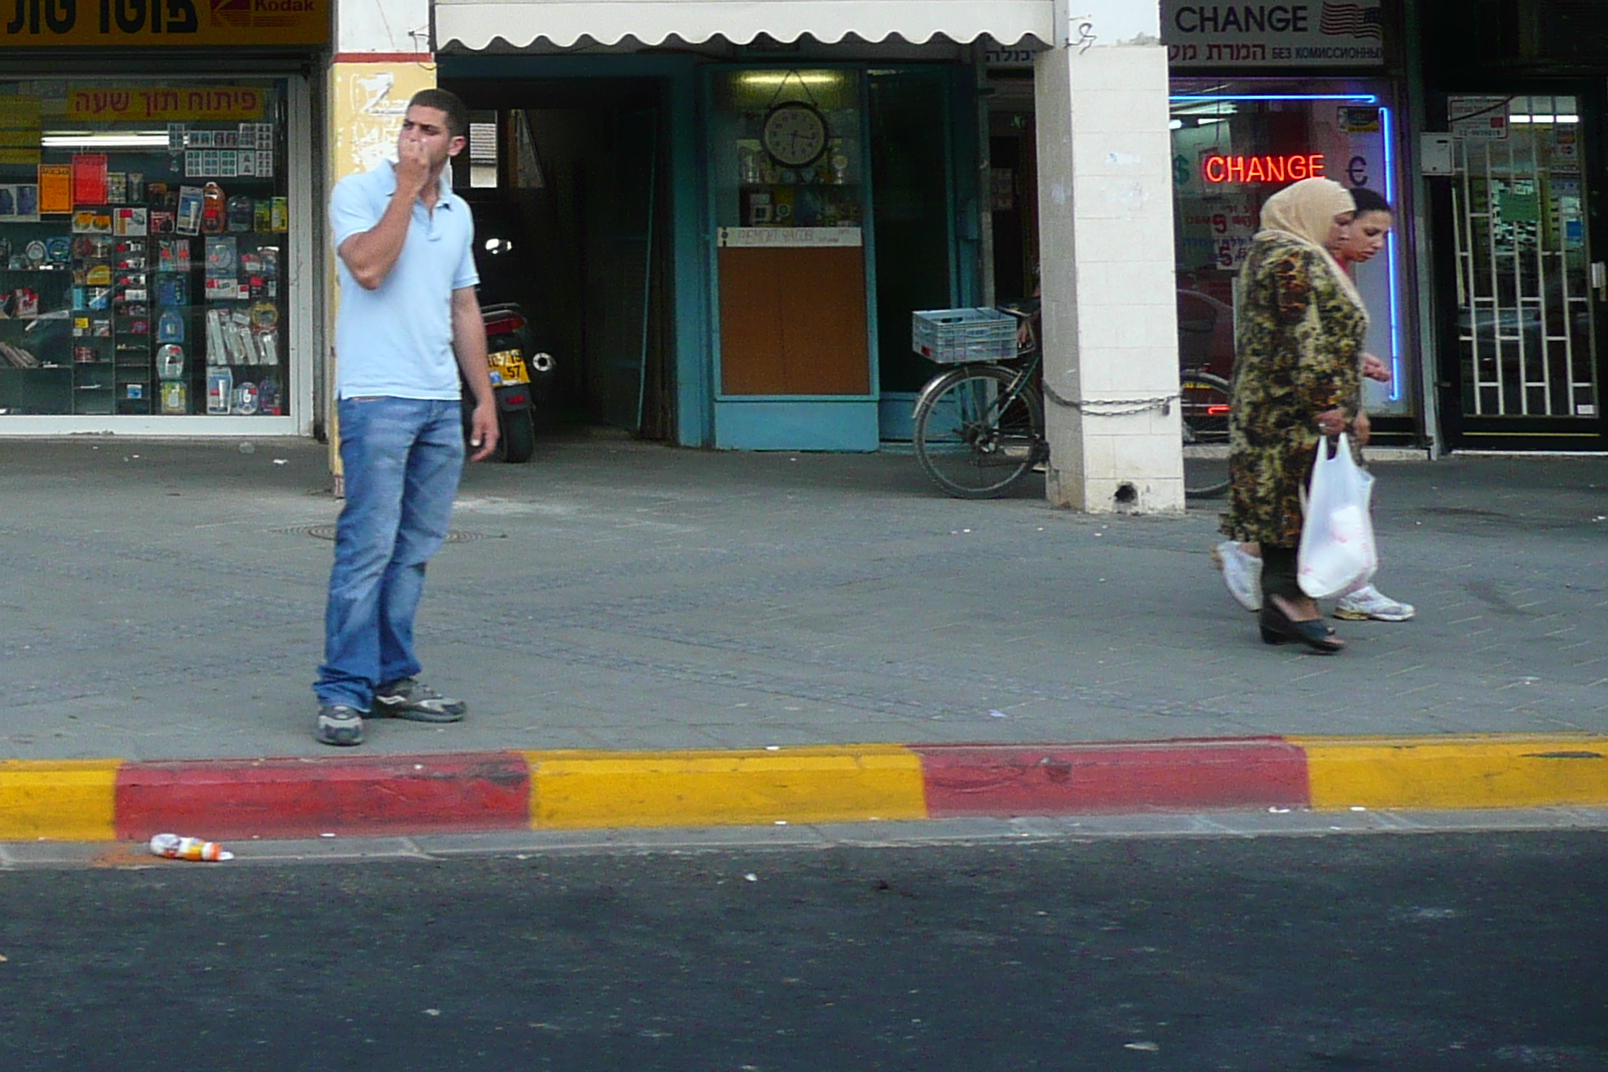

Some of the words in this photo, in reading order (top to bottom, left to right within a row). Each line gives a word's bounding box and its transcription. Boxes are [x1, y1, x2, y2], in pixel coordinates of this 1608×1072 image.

[1175, 5, 1308, 33] CHANGE
[1206, 43, 1267, 61] המרת
[1272, 48, 1292, 59] БЕЗ
[74, 90, 130, 115] שעה
[139, 91, 179, 117] תוך
[187, 90, 258, 112] פיתוח
[1204, 153, 1326, 184] CHANGE
